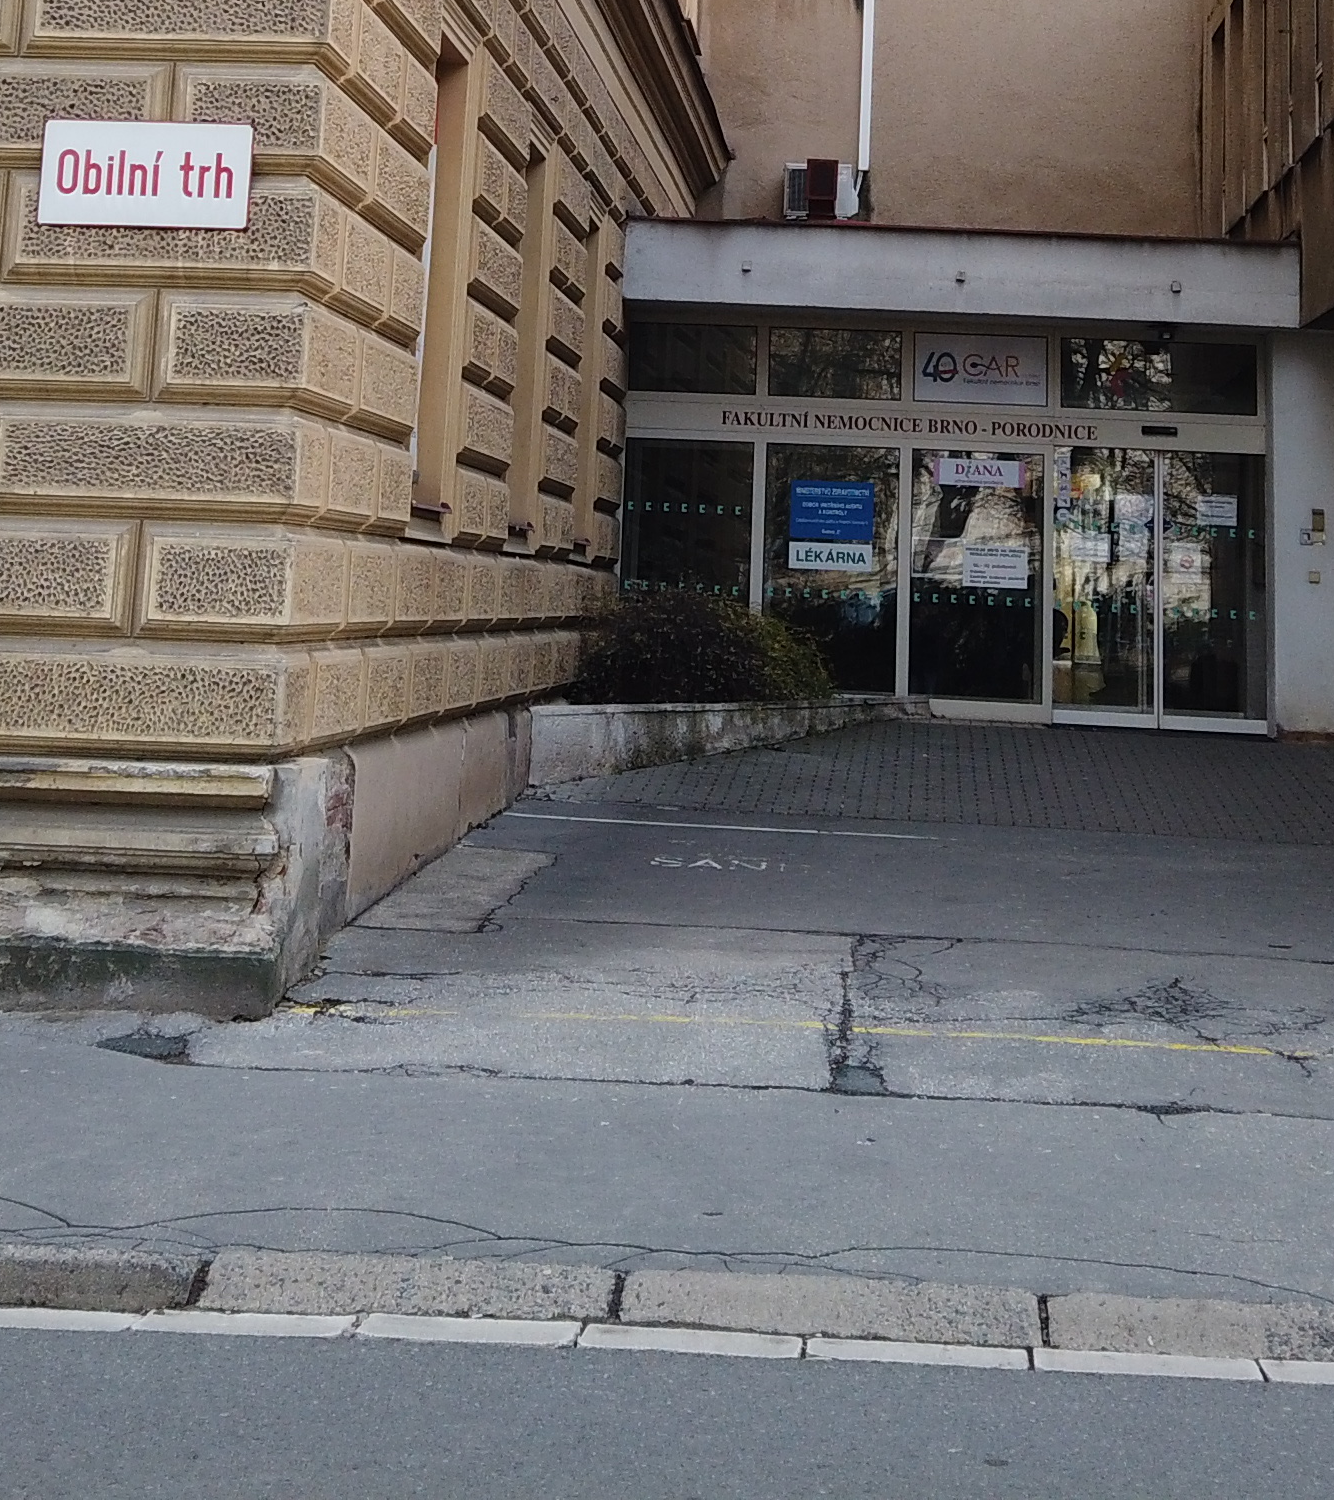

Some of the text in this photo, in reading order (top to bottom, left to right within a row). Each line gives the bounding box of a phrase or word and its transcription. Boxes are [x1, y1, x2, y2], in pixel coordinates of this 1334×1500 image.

[57, 148, 234, 199] Obilní trh
[962, 353, 1020, 378] CAR
[721, 410, 809, 429] FAKULTNÍ
[813, 414, 923, 433] NEMOCNICE
[927, 418, 978, 436] BRNO
[991, 421, 1098, 441] PORODNICE
[795, 547, 867, 565] LÉKÁRNA
